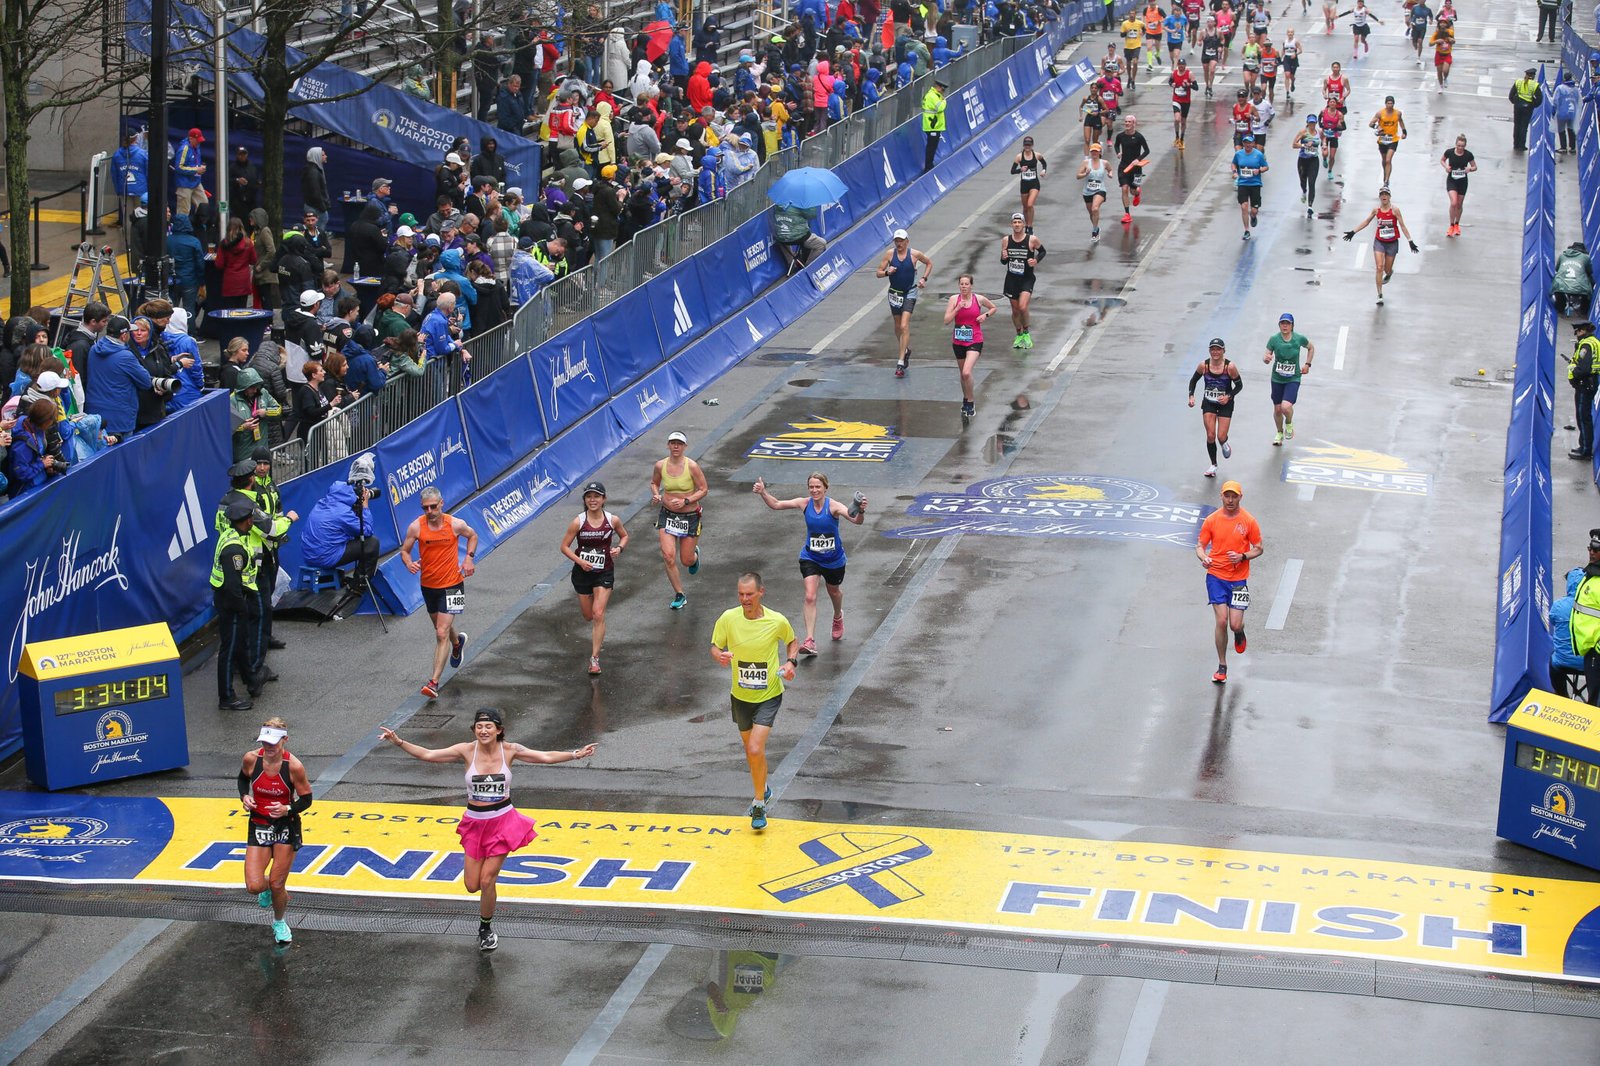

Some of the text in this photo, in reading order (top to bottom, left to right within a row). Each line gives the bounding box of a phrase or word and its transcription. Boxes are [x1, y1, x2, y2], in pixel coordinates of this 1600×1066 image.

[395, 124, 451, 153] MARATHO
[400, 115, 455, 144] THE BOSTO
[750, 449, 890, 460] BOSTON
[760, 441, 897, 452] ONE
[397, 465, 409, 482] THE
[408, 450, 434, 476] BOSTON
[1288, 464, 1428, 487] ONE
[401, 465, 437, 501] MARATHON
[491, 501, 505, 516] THE
[501, 488, 524, 511] BOSTON
[922, 503, 1198, 522] MARATHON
[928, 497, 1200, 516] 127TH BOSTON
[499, 501, 533, 531] MARATHON
[668, 518, 688, 532] 15308
[810, 538, 834, 550] 14217
[580, 552, 605, 565] 14970
[9, 513, 129, 684] John Hancock
[56, 651, 77, 661] 127TH
[78, 646, 114, 658] BOSTON
[60, 653, 117, 669] MARATHON
[739, 669, 767, 681] 14449
[73, 675, 167, 710] 3:34:04
[1539, 713, 1588, 733] MARATHON
[1543, 705, 1592, 726] 127TH BOSTON
[84, 734, 148, 751] BOSTON MARATHON
[91, 749, 143, 774] John Hancock
[473, 782, 505, 794] 15214
[332, 811, 460, 825] BOSTO
[540, 821, 733, 836] ARATHON
[1530, 805, 1586, 830] BOSTON MARATHON
[20, 838, 134, 846] MARATHON
[1532, 822, 1577, 850] John Hancock
[825, 855, 912, 882] BOSTON
[1000, 845, 1534, 897] 127TH BOSTON MARATHON
[996, 880, 1528, 958] FINISH
